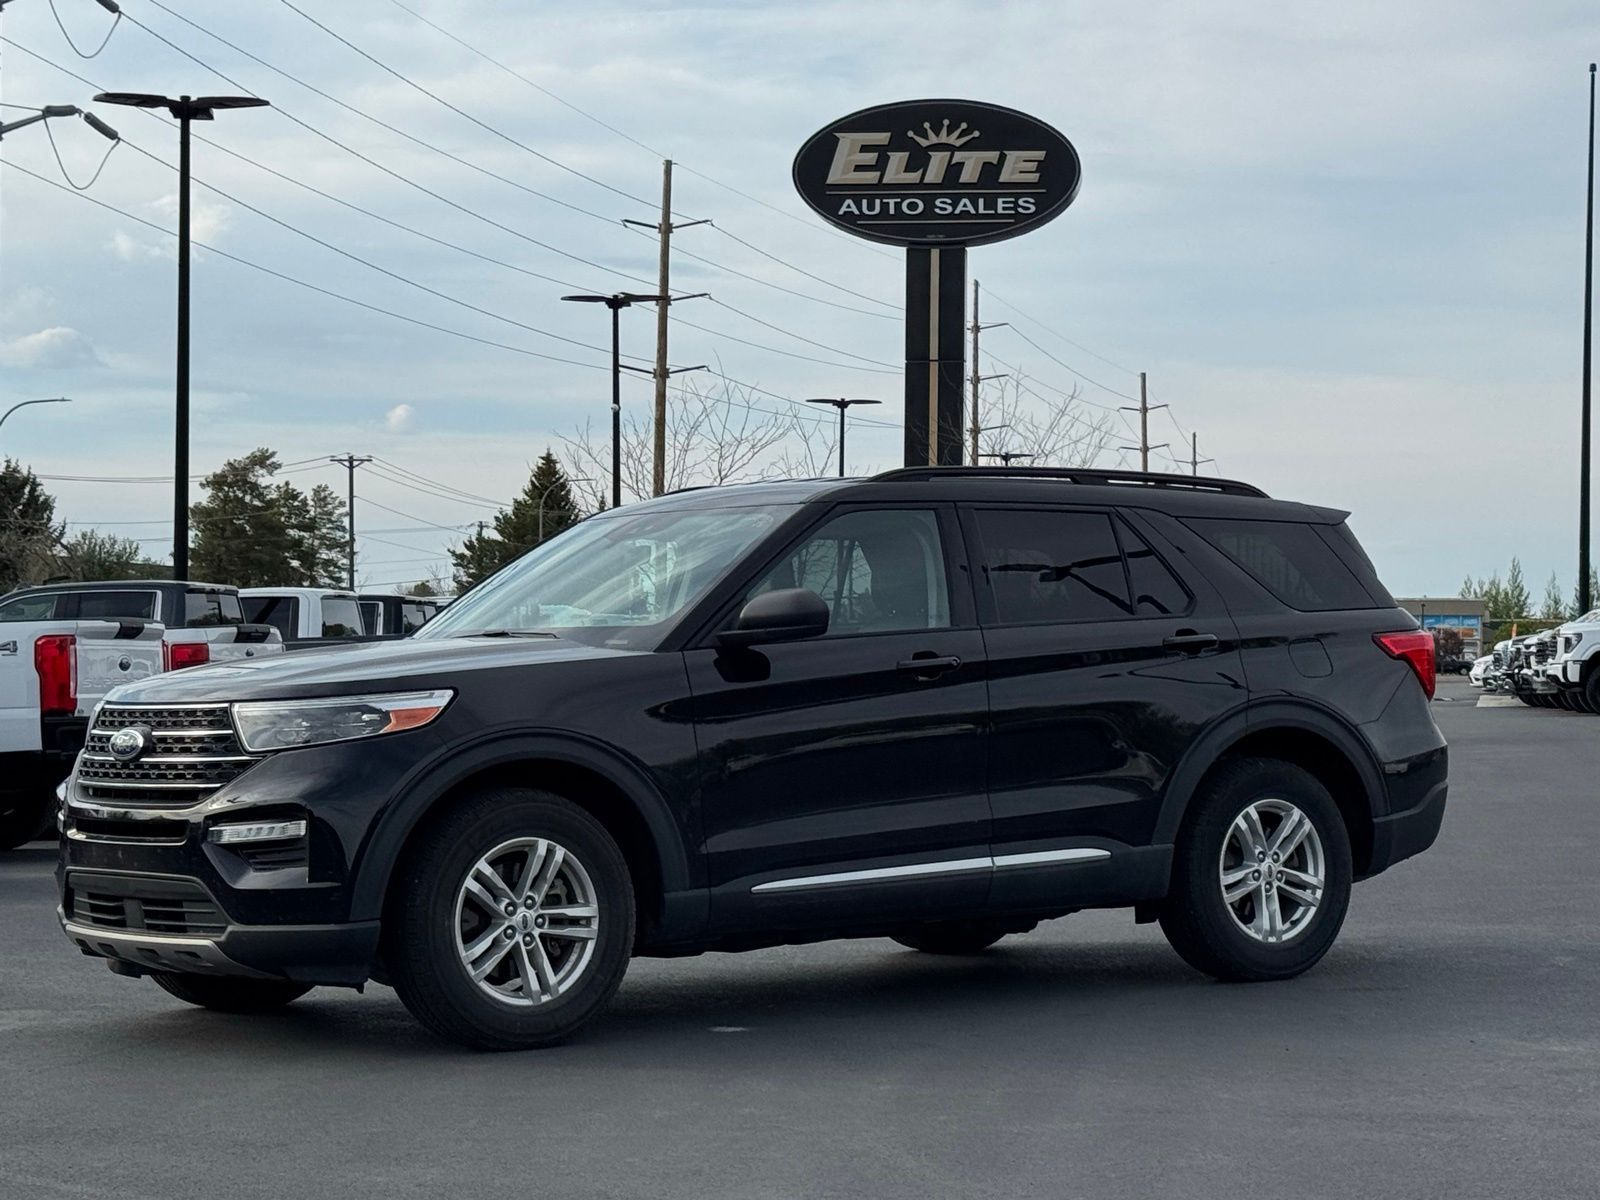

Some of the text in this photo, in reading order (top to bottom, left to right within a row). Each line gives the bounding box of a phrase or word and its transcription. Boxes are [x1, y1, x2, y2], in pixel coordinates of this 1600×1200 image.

[826, 132, 1047, 185] ELITE
[838, 197, 1036, 215] AUTO SALES
